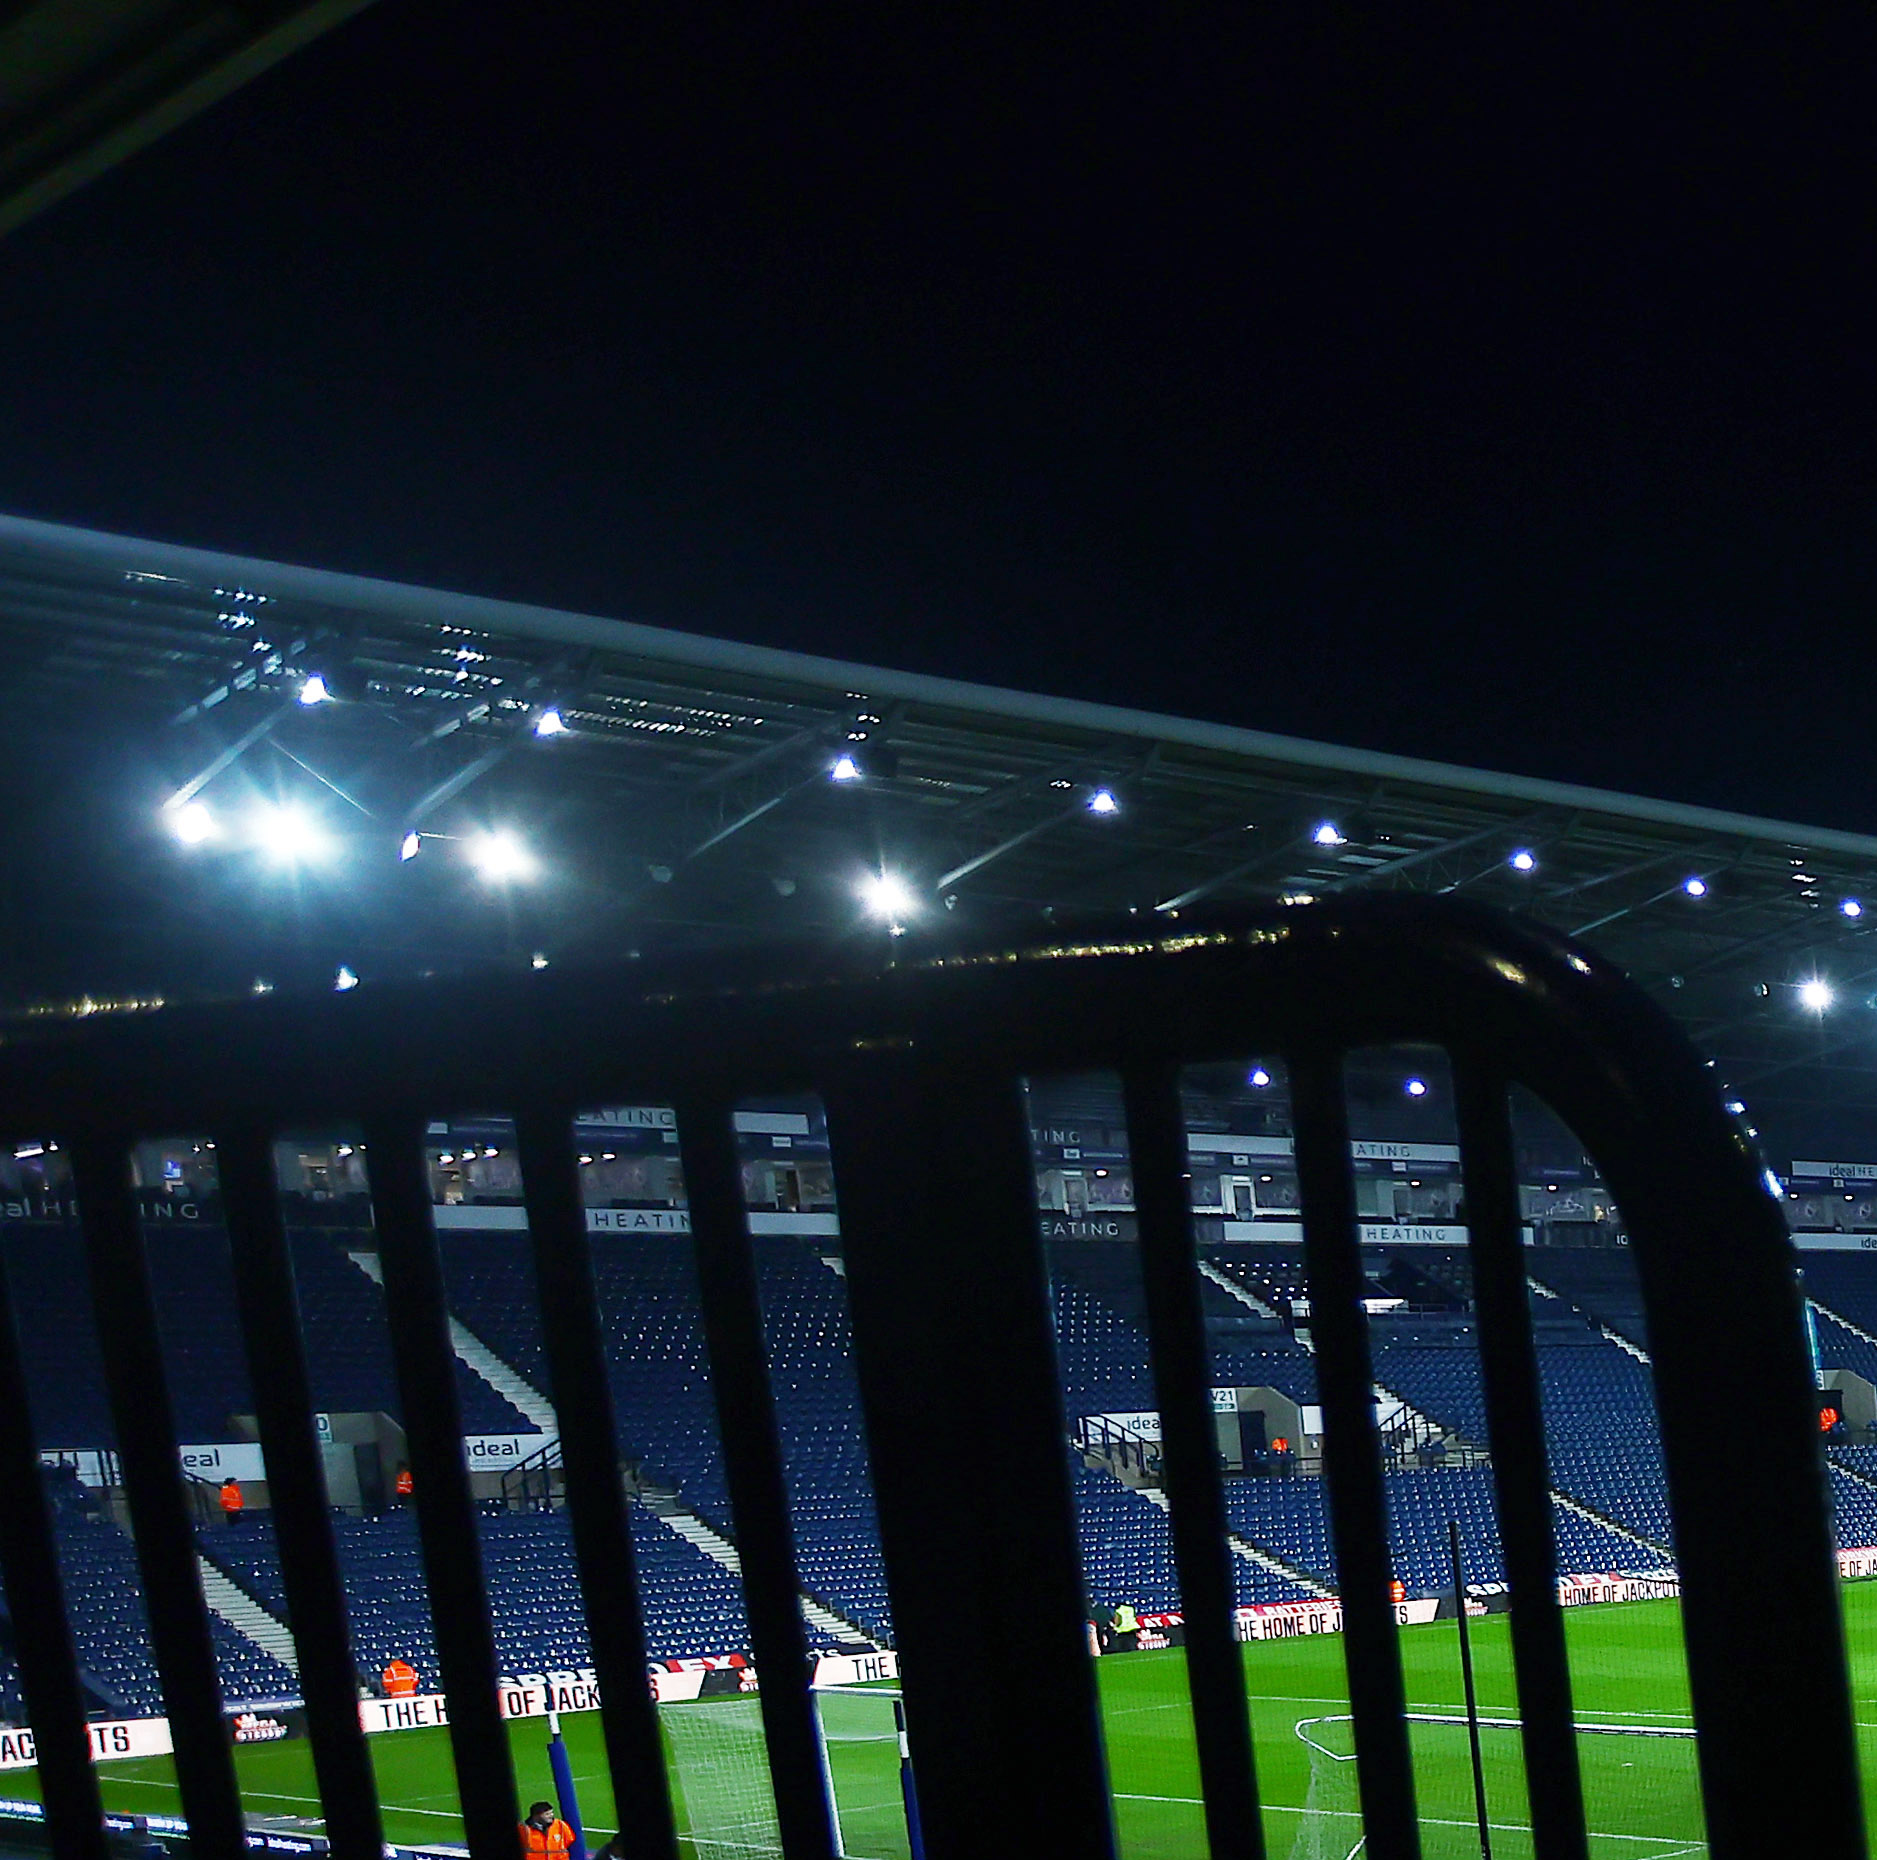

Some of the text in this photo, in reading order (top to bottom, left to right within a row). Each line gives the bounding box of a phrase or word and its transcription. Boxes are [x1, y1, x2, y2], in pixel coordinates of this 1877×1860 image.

[1357, 1145, 1411, 1158] ATING
[595, 1213, 691, 1230] HEATIN
[1041, 1220, 1120, 1237] EATING
[1367, 1227, 1446, 1241] HEATING
[1127, 1415, 1161, 1431] idea
[182, 1448, 221, 1469] eal
[1849, 1560, 1862, 1576] OF
[1563, 1580, 1680, 1607] HOME OF JACKPOT
[1238, 1620, 1258, 1642] HE
[1262, 1616, 1307, 1641] HOME
[1310, 1613, 1328, 1635] OF
[851, 1656, 890, 1681] THE
[379, 1701, 429, 1728] THE
[507, 1689, 535, 1716] OF
